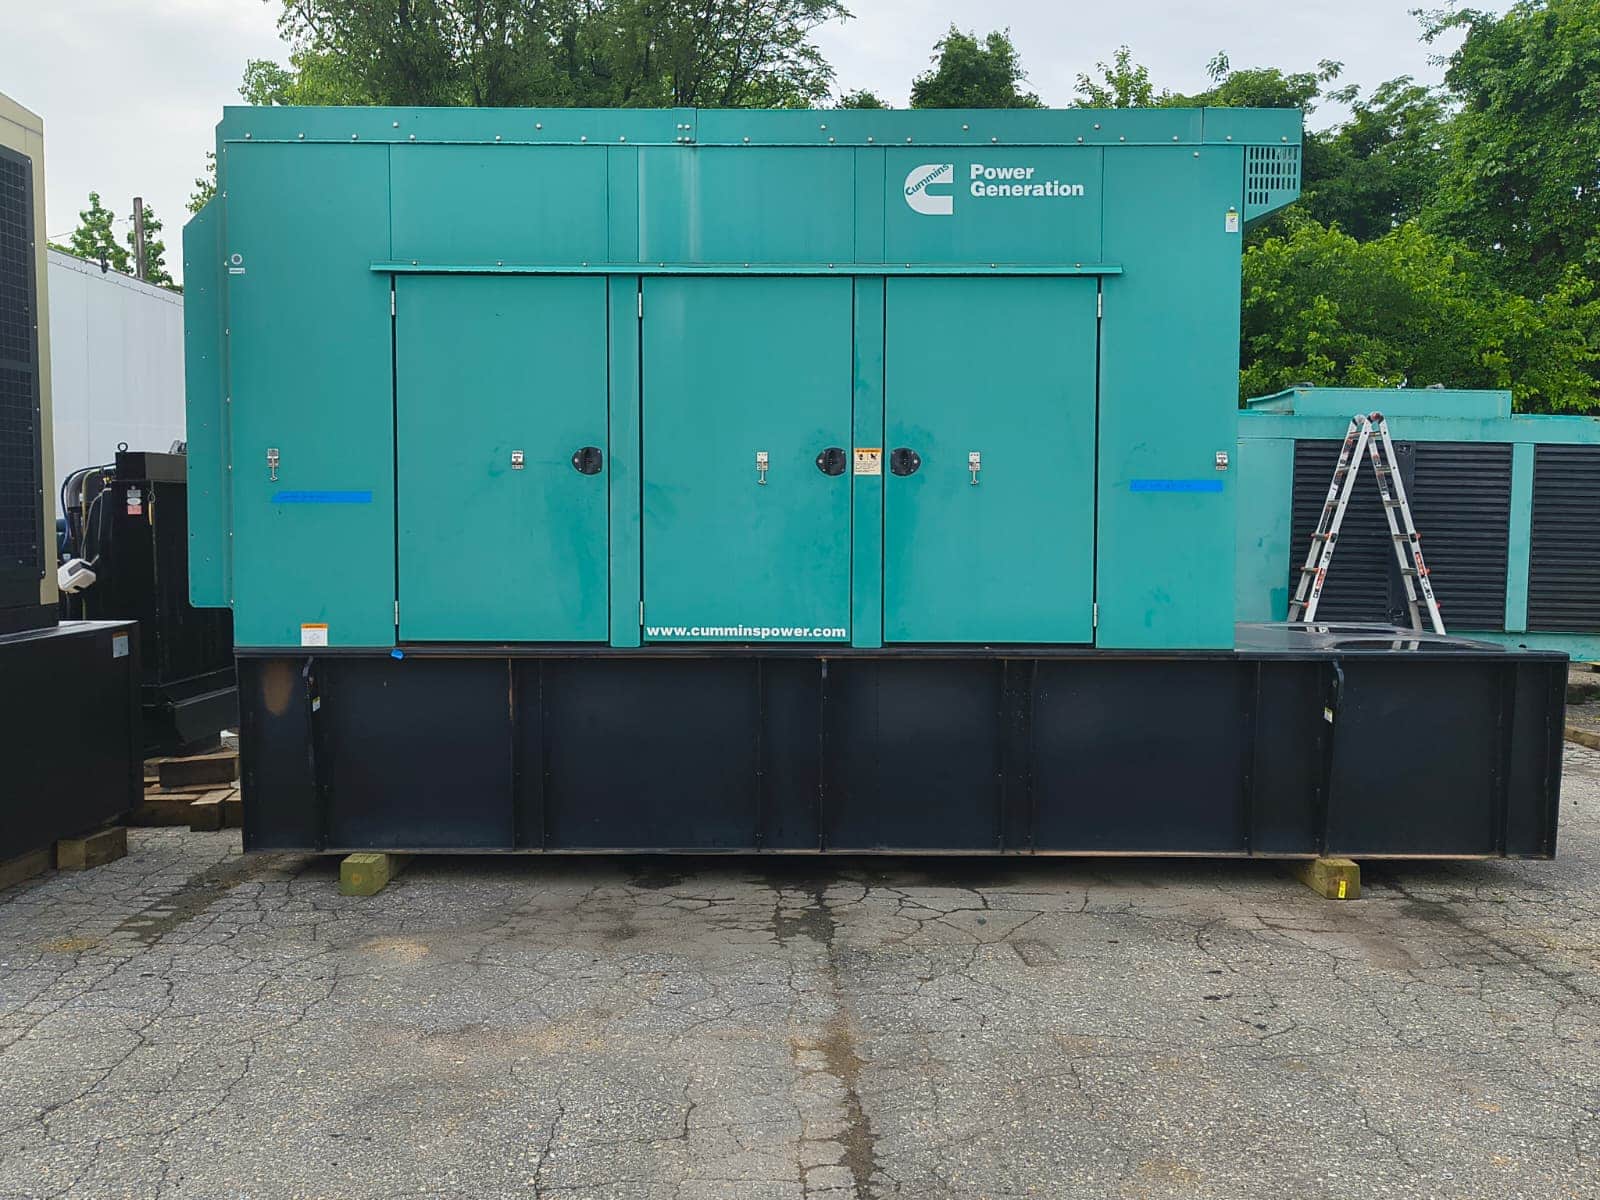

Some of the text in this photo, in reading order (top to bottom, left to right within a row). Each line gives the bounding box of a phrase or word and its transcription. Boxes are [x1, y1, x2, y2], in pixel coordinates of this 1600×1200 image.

[905, 163, 950, 197] Cummins
[970, 164, 1034, 180] Power
[970, 180, 1084, 197] Generation
[646, 625, 847, 639] www.cumminspower.com
